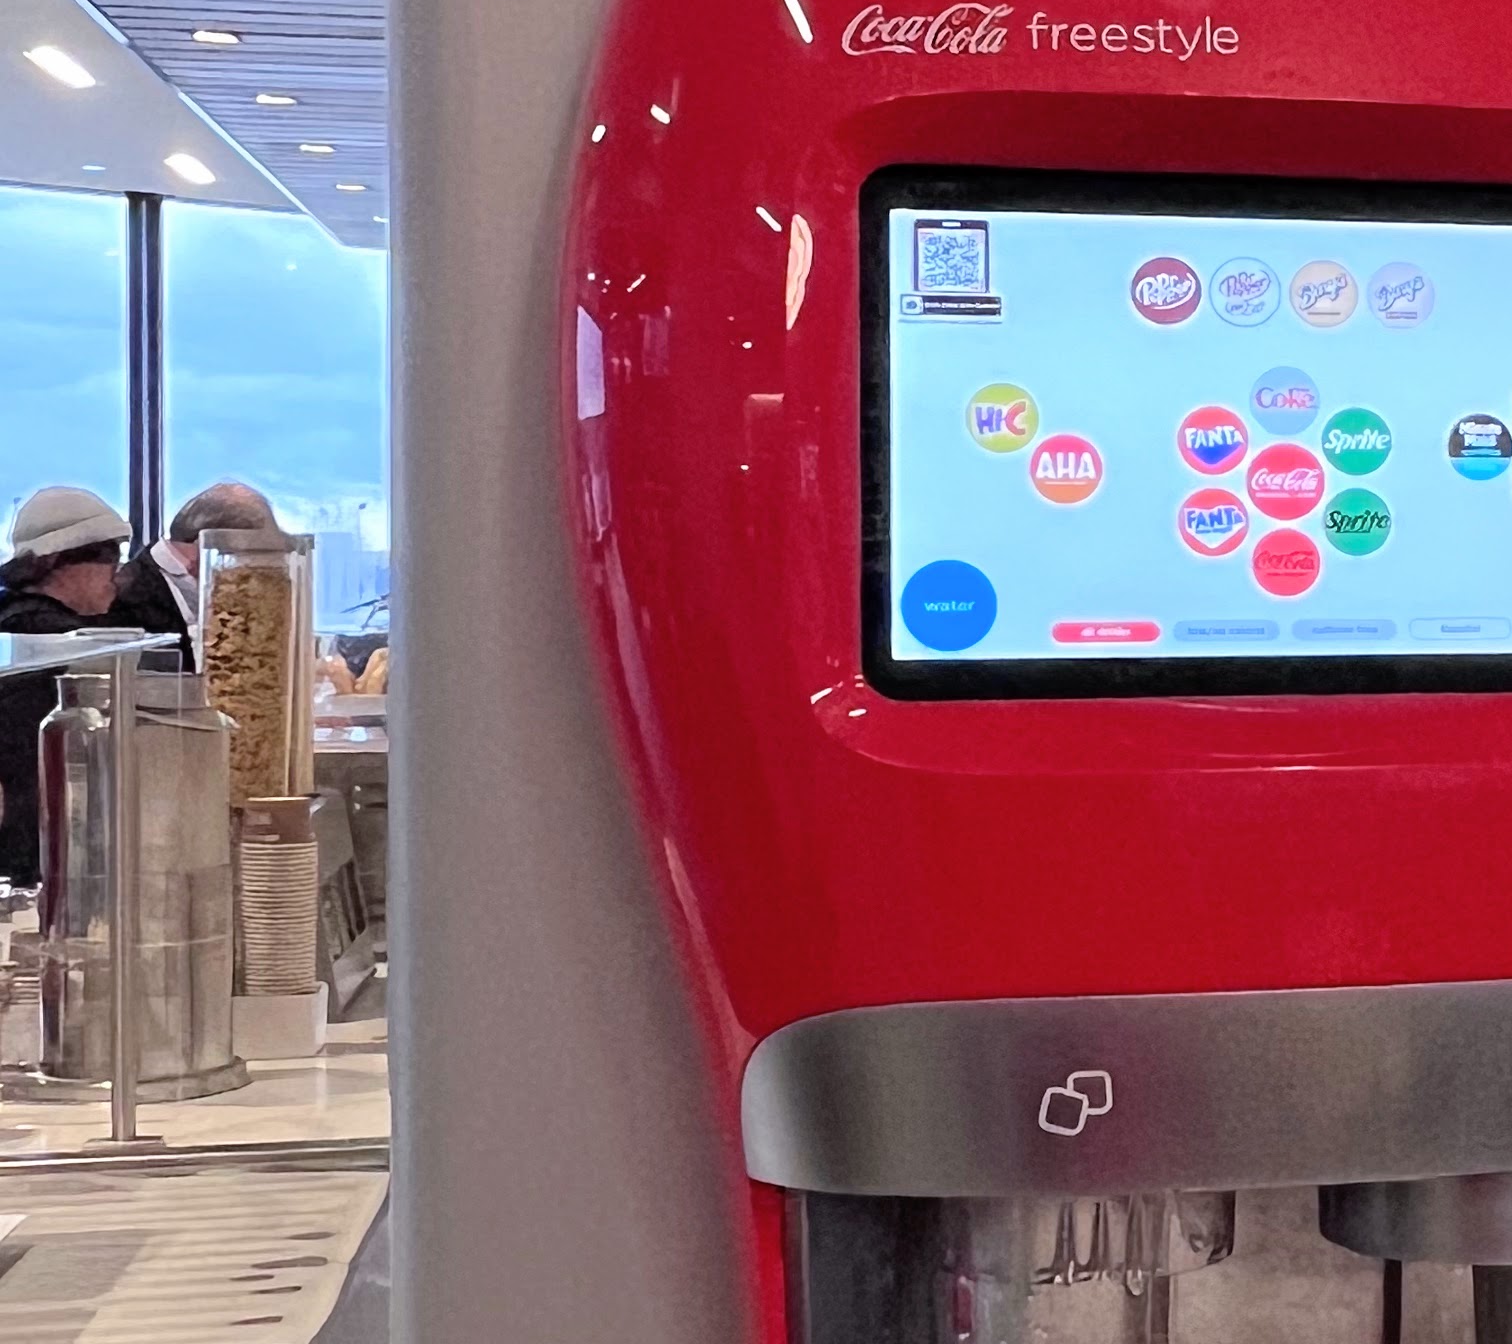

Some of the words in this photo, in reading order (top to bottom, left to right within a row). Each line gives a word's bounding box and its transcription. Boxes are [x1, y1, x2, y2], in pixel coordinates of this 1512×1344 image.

[1026, 11, 1240, 62] freestyle
[1323, 428, 1391, 454] Sprite
[1035, 451, 1096, 480] AHA
